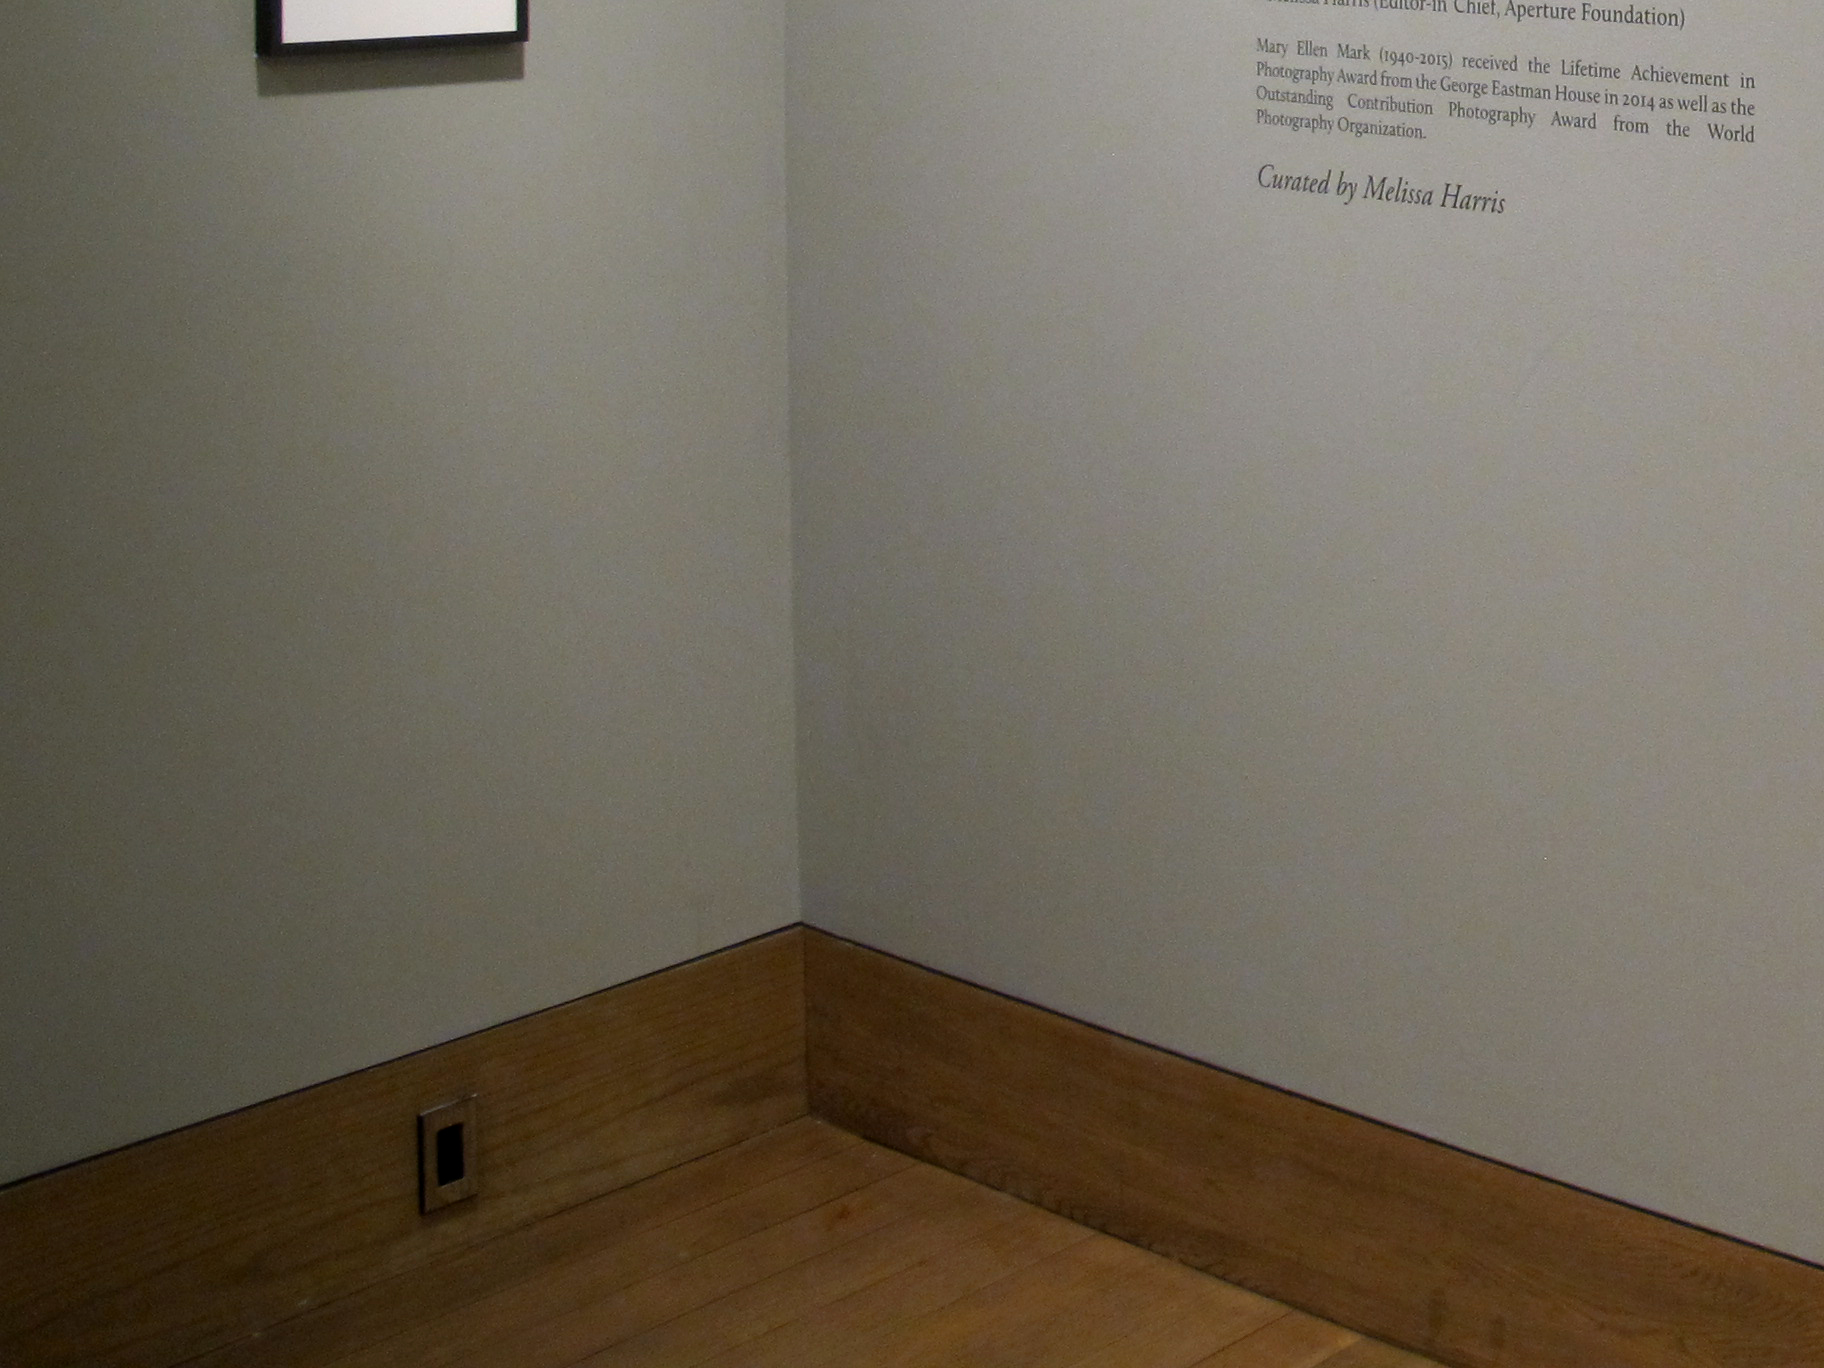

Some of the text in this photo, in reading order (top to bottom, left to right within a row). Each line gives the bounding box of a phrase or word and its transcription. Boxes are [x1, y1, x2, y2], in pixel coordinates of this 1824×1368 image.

[1505, 0, 1576, 22] Aperture
[1582, 3, 1685, 29] Foundation)
[1258, 38, 1755, 88] Mary Ellen Mark (1940-2015) received the Lifetime Achievement in
[1257, 62, 1755, 116] Photography Award from the George Eastman House in 2014 as well as the
[1257, 85, 1755, 142] Outstanding Contribution Photography Award from the World
[1257, 109, 1426, 139] Photography Organization.
[1258, 164, 1506, 214] Curated by Melissa Harris
